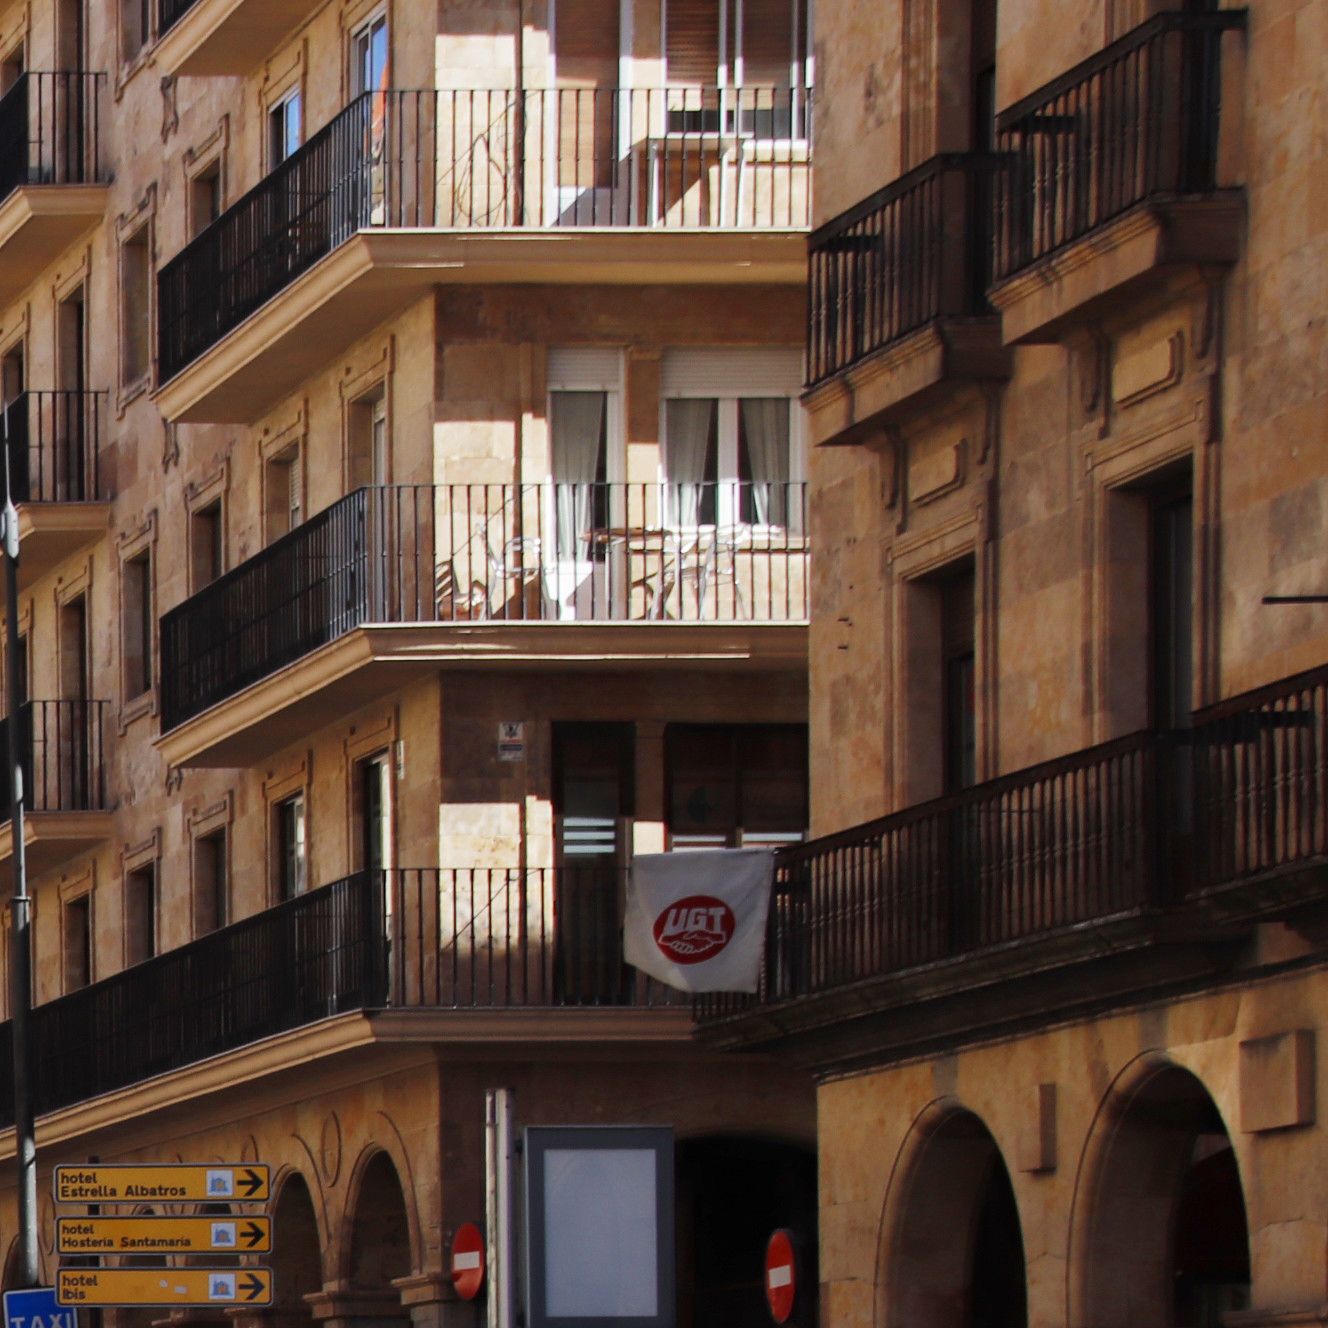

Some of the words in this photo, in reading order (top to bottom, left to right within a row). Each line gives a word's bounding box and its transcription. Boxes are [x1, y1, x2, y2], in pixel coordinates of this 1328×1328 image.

[663, 907, 725, 936] UGT
[61, 1173, 97, 1184] hotel
[61, 1186, 117, 1197] Estrella
[125, 1185, 186, 1197] Albatros
[62, 1224, 94, 1234] hotel
[62, 1275, 98, 1286] hotel
